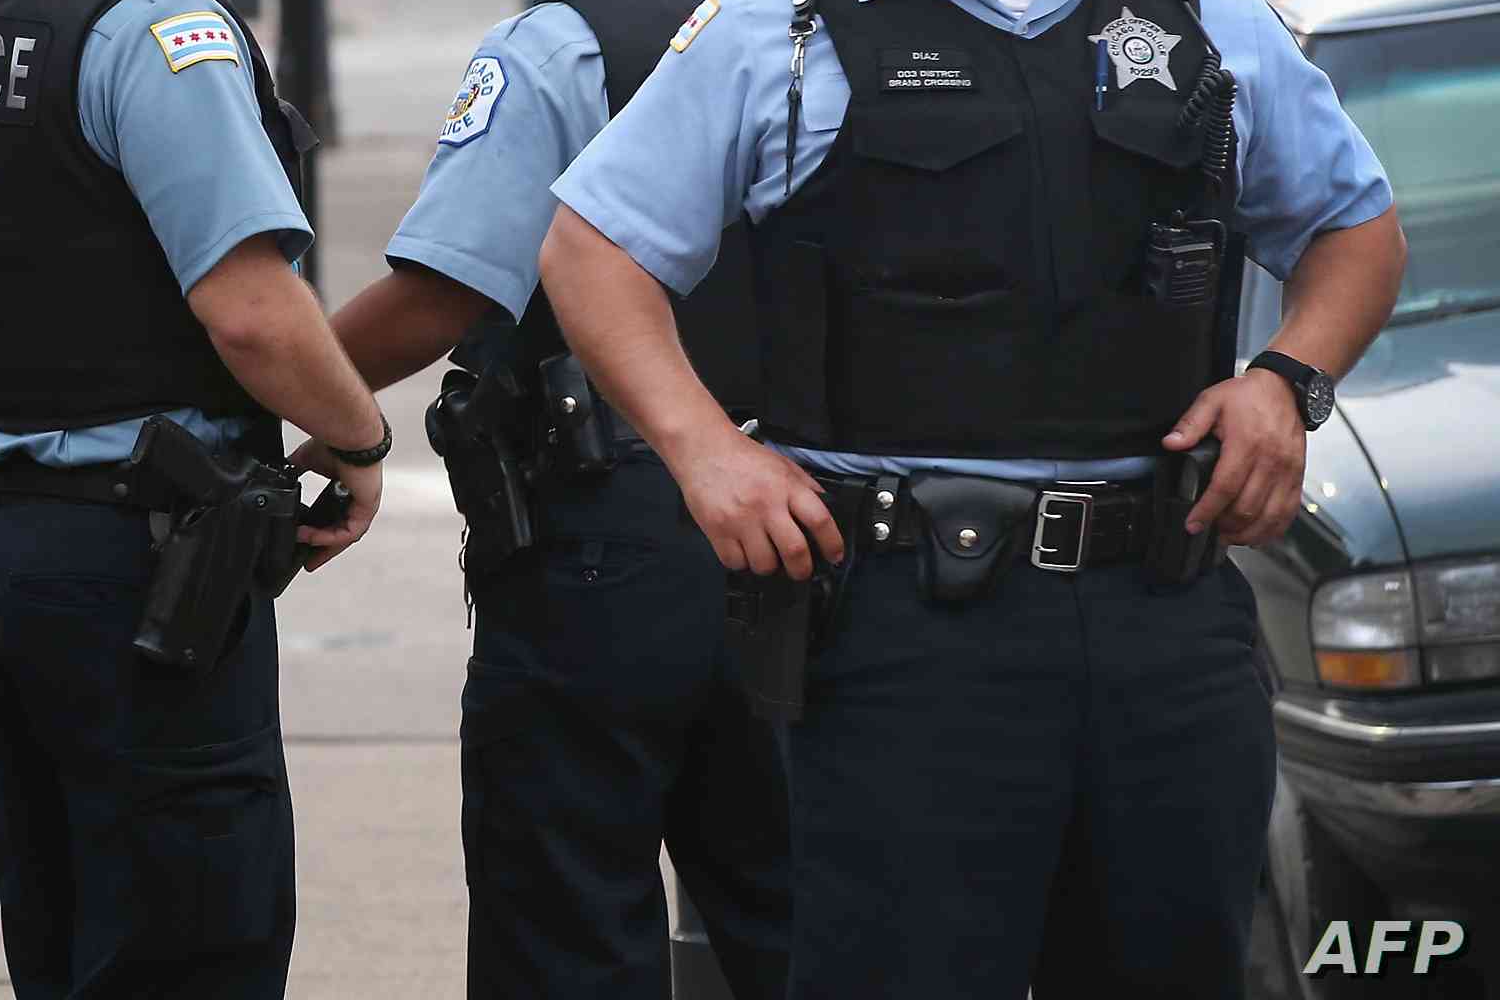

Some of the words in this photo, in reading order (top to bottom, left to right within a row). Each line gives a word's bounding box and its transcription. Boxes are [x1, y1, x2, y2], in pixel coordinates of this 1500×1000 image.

[1110, 26, 1134, 56] CHICAGO
[1140, 27, 1167, 56] POLICE
[912, 51, 940, 61] DIAZ
